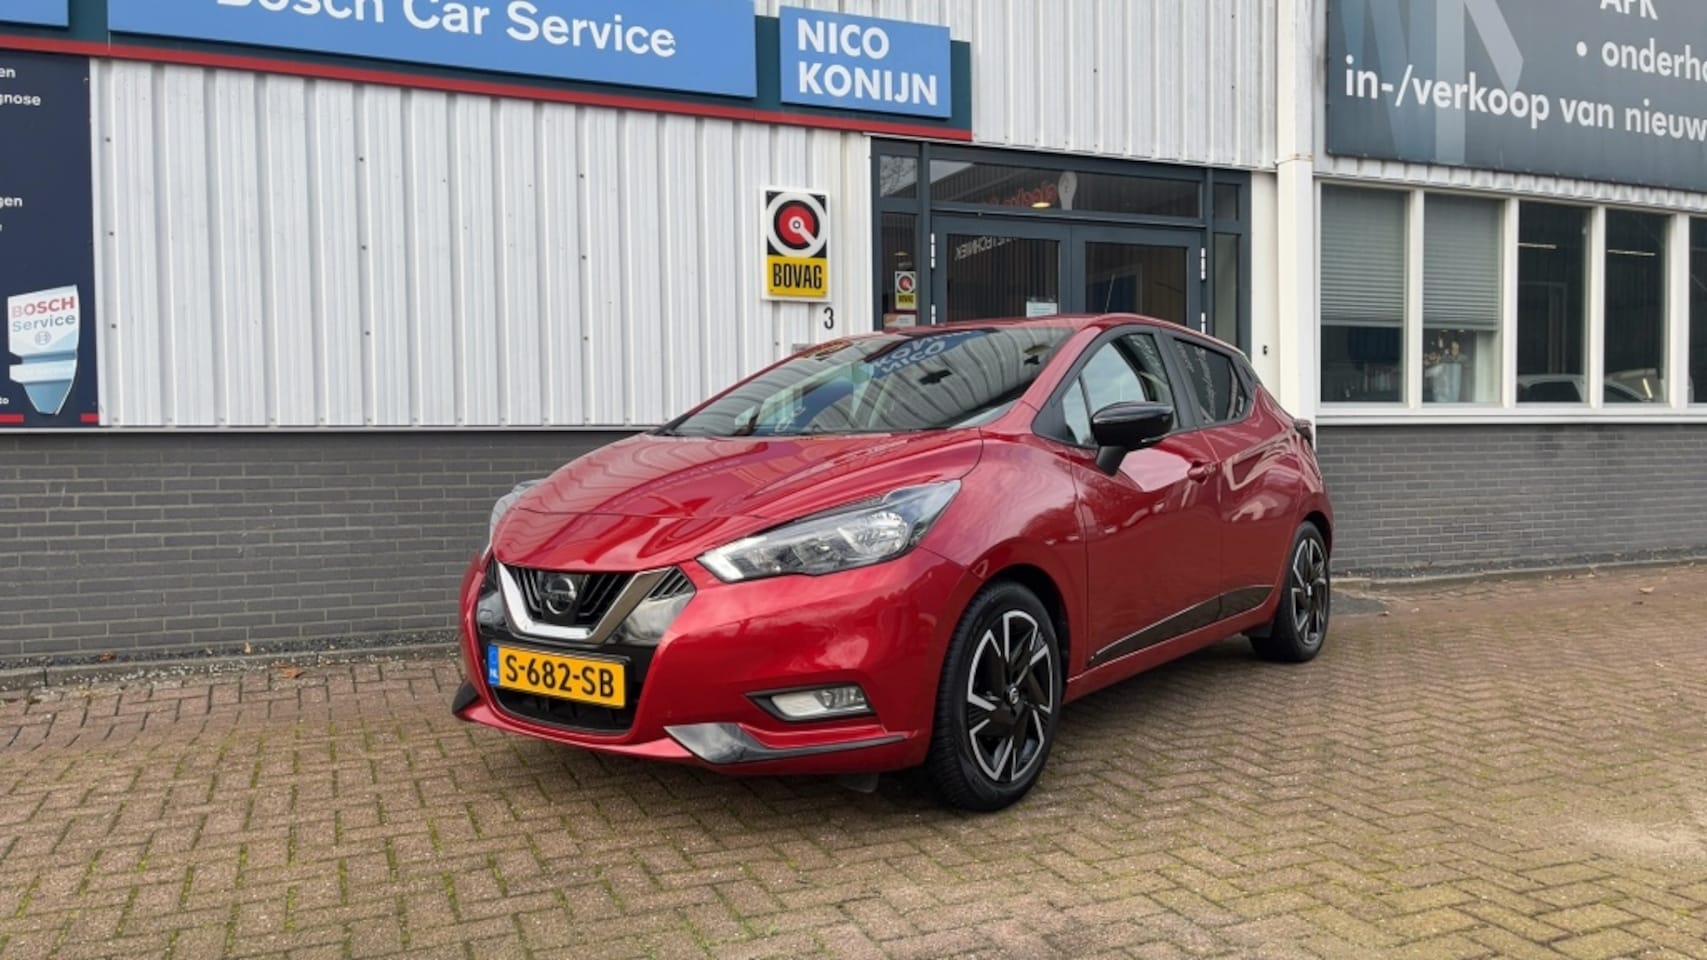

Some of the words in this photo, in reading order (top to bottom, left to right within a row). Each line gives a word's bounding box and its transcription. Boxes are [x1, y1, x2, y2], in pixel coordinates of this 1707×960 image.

[403, 0, 490, 35] Car
[506, 0, 676, 57] Service
[798, 18, 890, 60] NICO
[798, 61, 937, 106] KONIJN
[1346, 54, 1550, 129] in-/verkoop
[1560, 98, 1614, 129] van
[773, 263, 823, 289] BOVAG
[11, 296, 76, 319] BOSCH
[12, 313, 76, 333] Service
[823, 306, 835, 330] 3
[505, 655, 614, 698] S-682-SB
